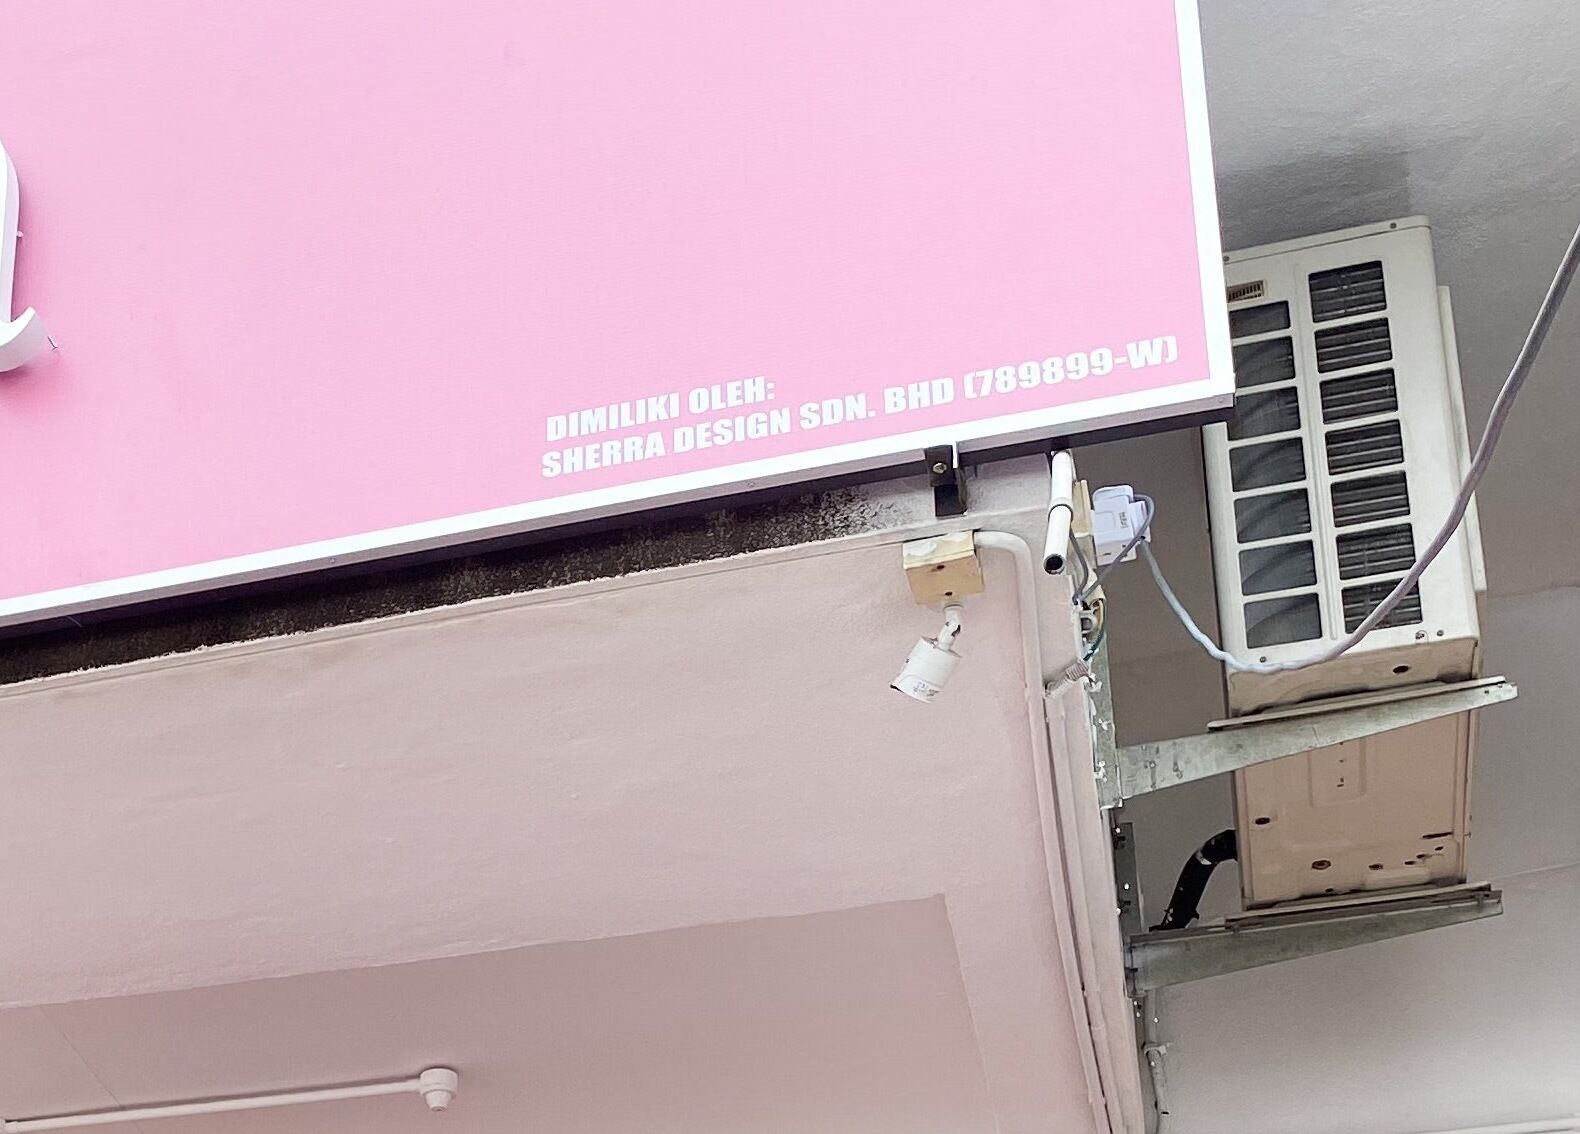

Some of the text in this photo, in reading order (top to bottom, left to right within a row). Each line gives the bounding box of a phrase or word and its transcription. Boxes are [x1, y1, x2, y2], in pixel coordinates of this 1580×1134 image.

[541, 335, 1179, 479] SHERRA DESIGN SDN. BHD (789899-W)
[545, 376, 776, 442] DIMILIKI OLEH:
